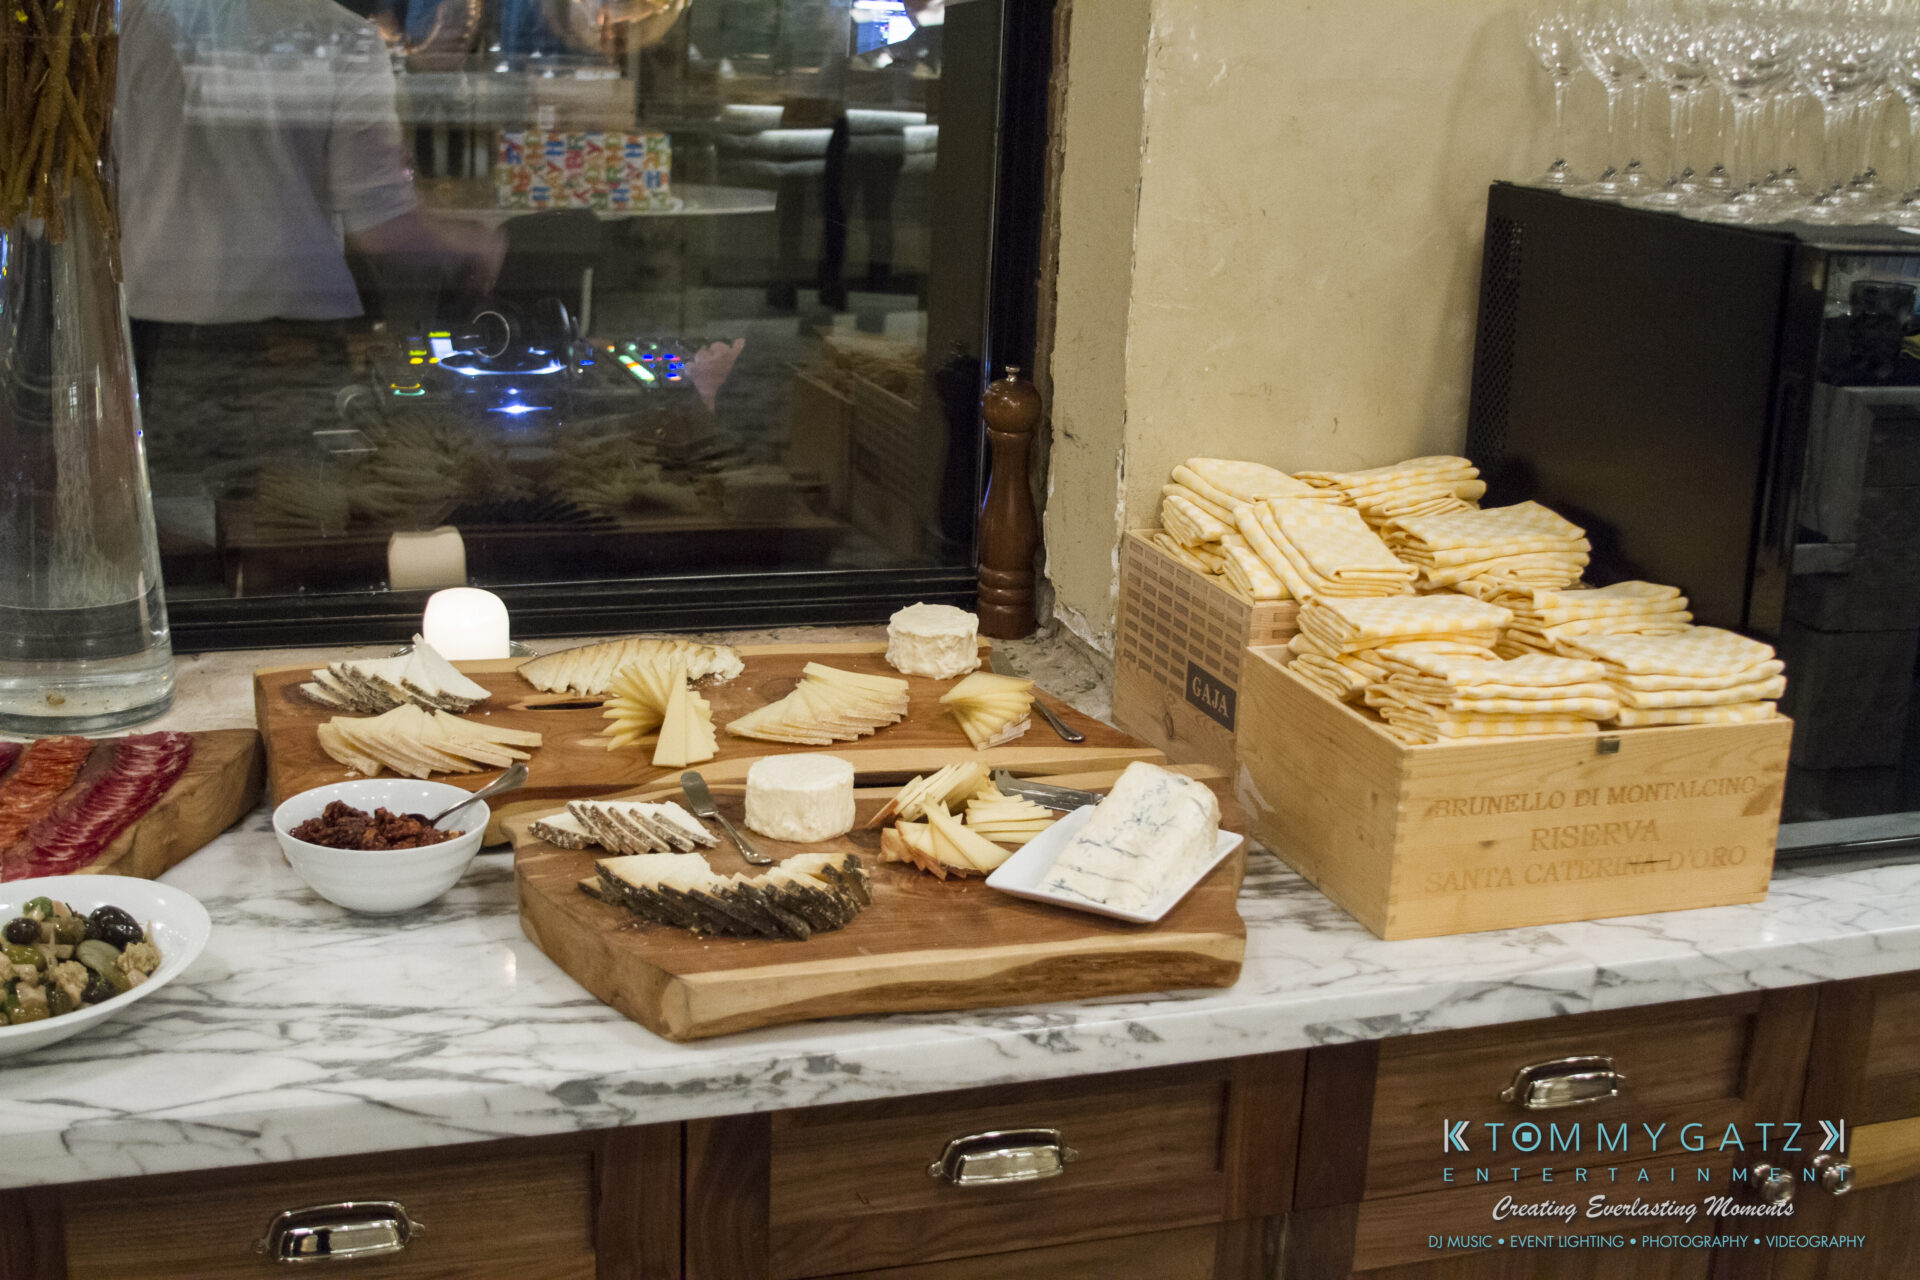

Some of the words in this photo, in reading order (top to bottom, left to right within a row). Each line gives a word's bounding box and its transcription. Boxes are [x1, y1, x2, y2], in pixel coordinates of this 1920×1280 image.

[1192, 676, 1230, 719] GAJA
[1432, 789, 1566, 818] BRUNELLO
[1574, 786, 1599, 808] DI
[1607, 775, 1758, 805] MONTALCINO
[1530, 819, 1661, 852] RISERVA
[1424, 867, 1514, 893] SANTA
[1524, 852, 1659, 885] CATERINA
[1666, 844, 1748, 872] D'ORO
